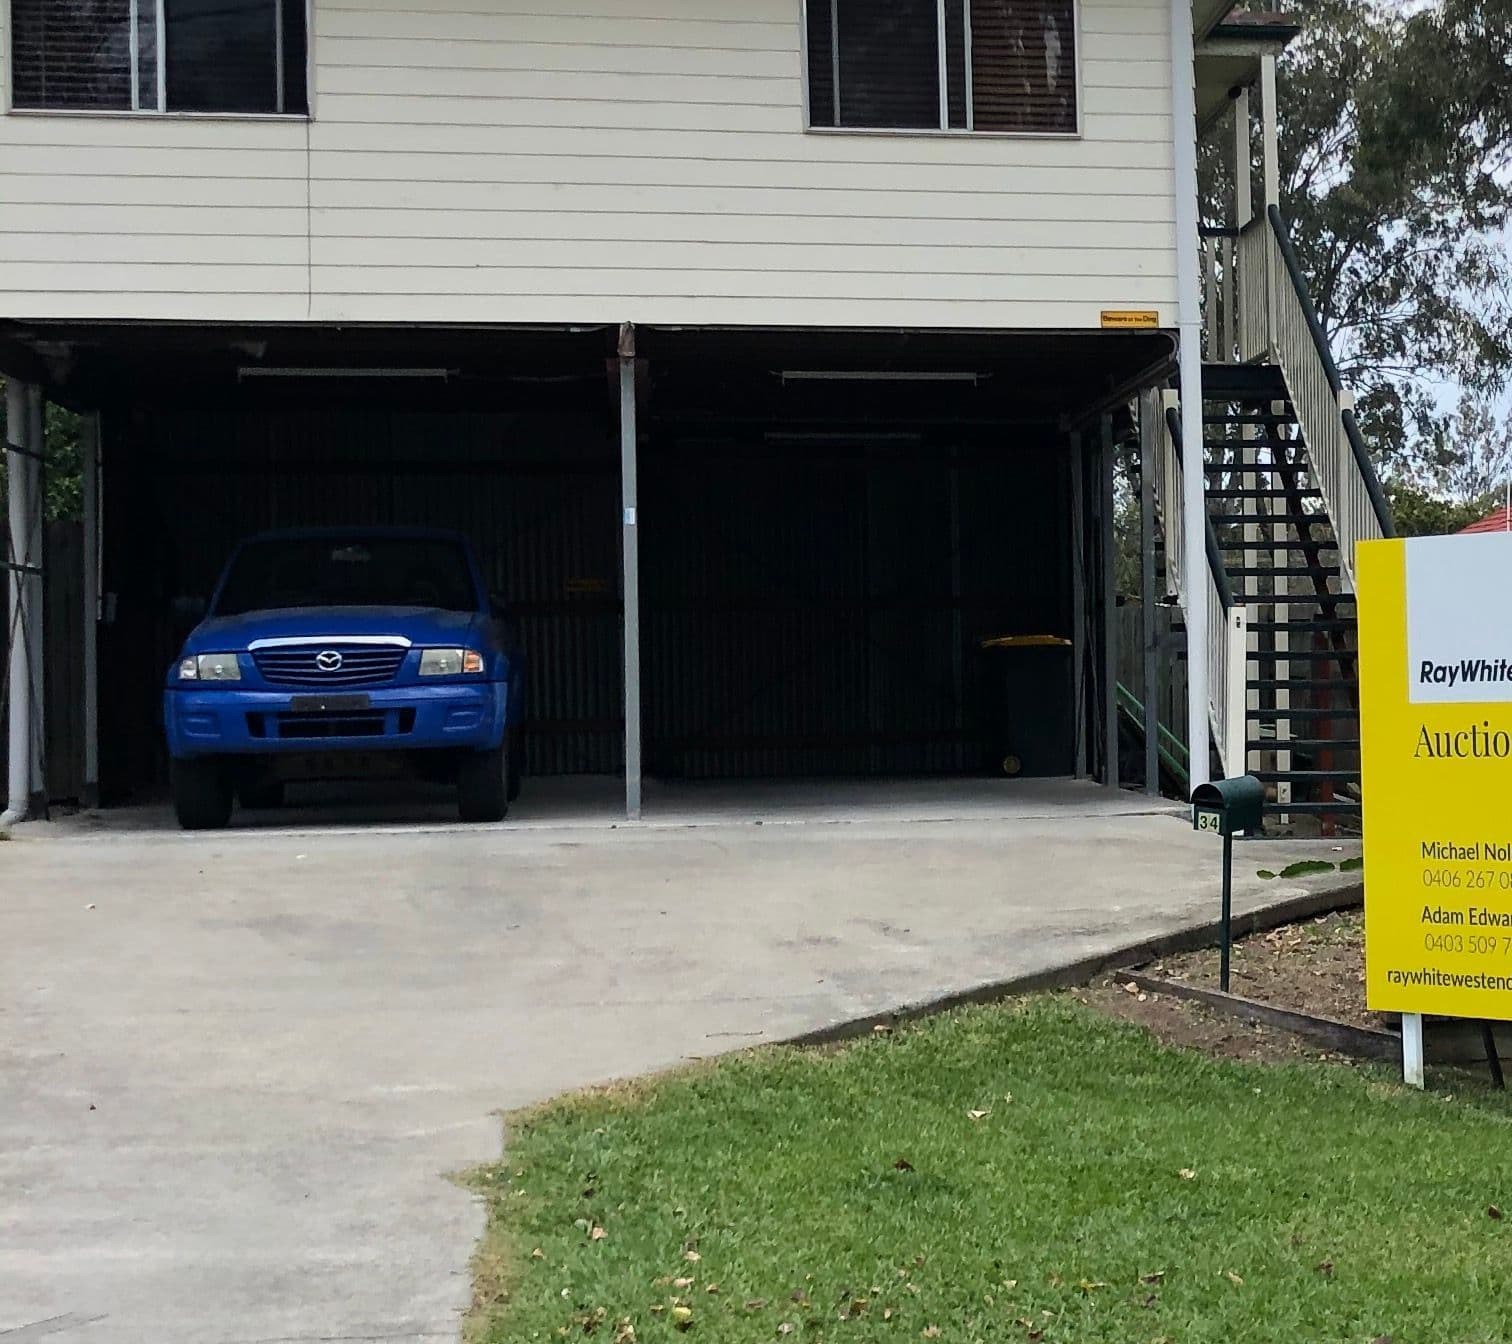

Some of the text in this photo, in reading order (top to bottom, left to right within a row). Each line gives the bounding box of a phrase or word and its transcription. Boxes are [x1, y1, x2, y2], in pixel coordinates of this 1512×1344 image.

[1200, 816, 1218, 829] 34
[1421, 841, 1480, 861] Michael
[1423, 869, 1461, 887] 0406
[1466, 870, 1494, 888] 267
[1421, 906, 1464, 925] Adam
[1424, 934, 1464, 952] 0403
[1468, 935, 1497, 954] 509
